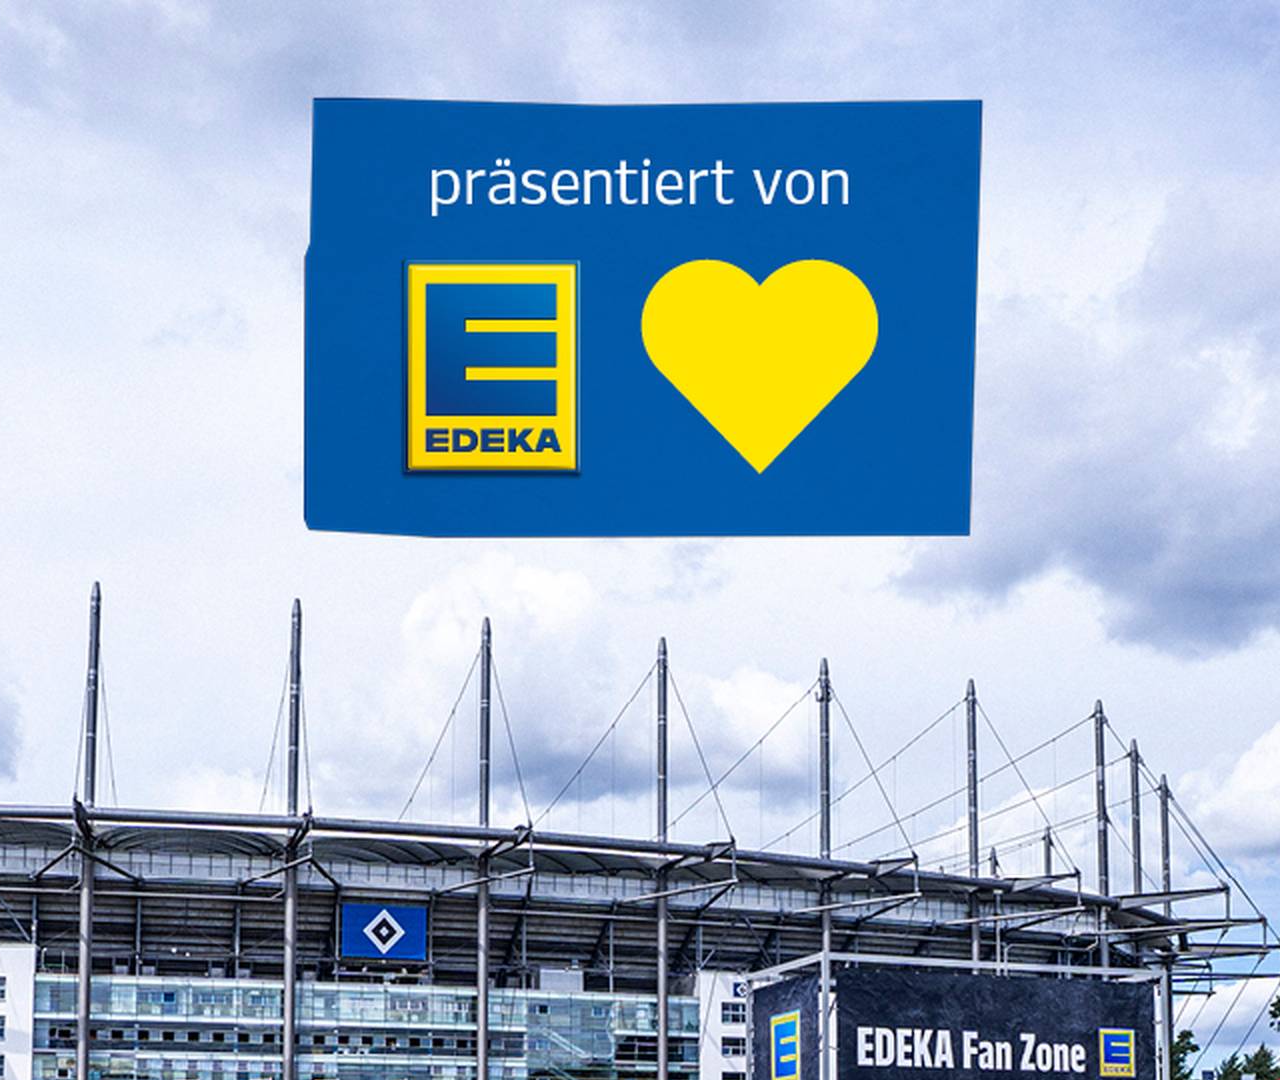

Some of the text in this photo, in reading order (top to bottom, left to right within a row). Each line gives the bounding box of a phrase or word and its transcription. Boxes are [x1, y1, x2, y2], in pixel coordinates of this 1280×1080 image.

[857, 1026, 1086, 1073] EDEKA Fan Zone
[1103, 1066, 1132, 1074] EDEKA
